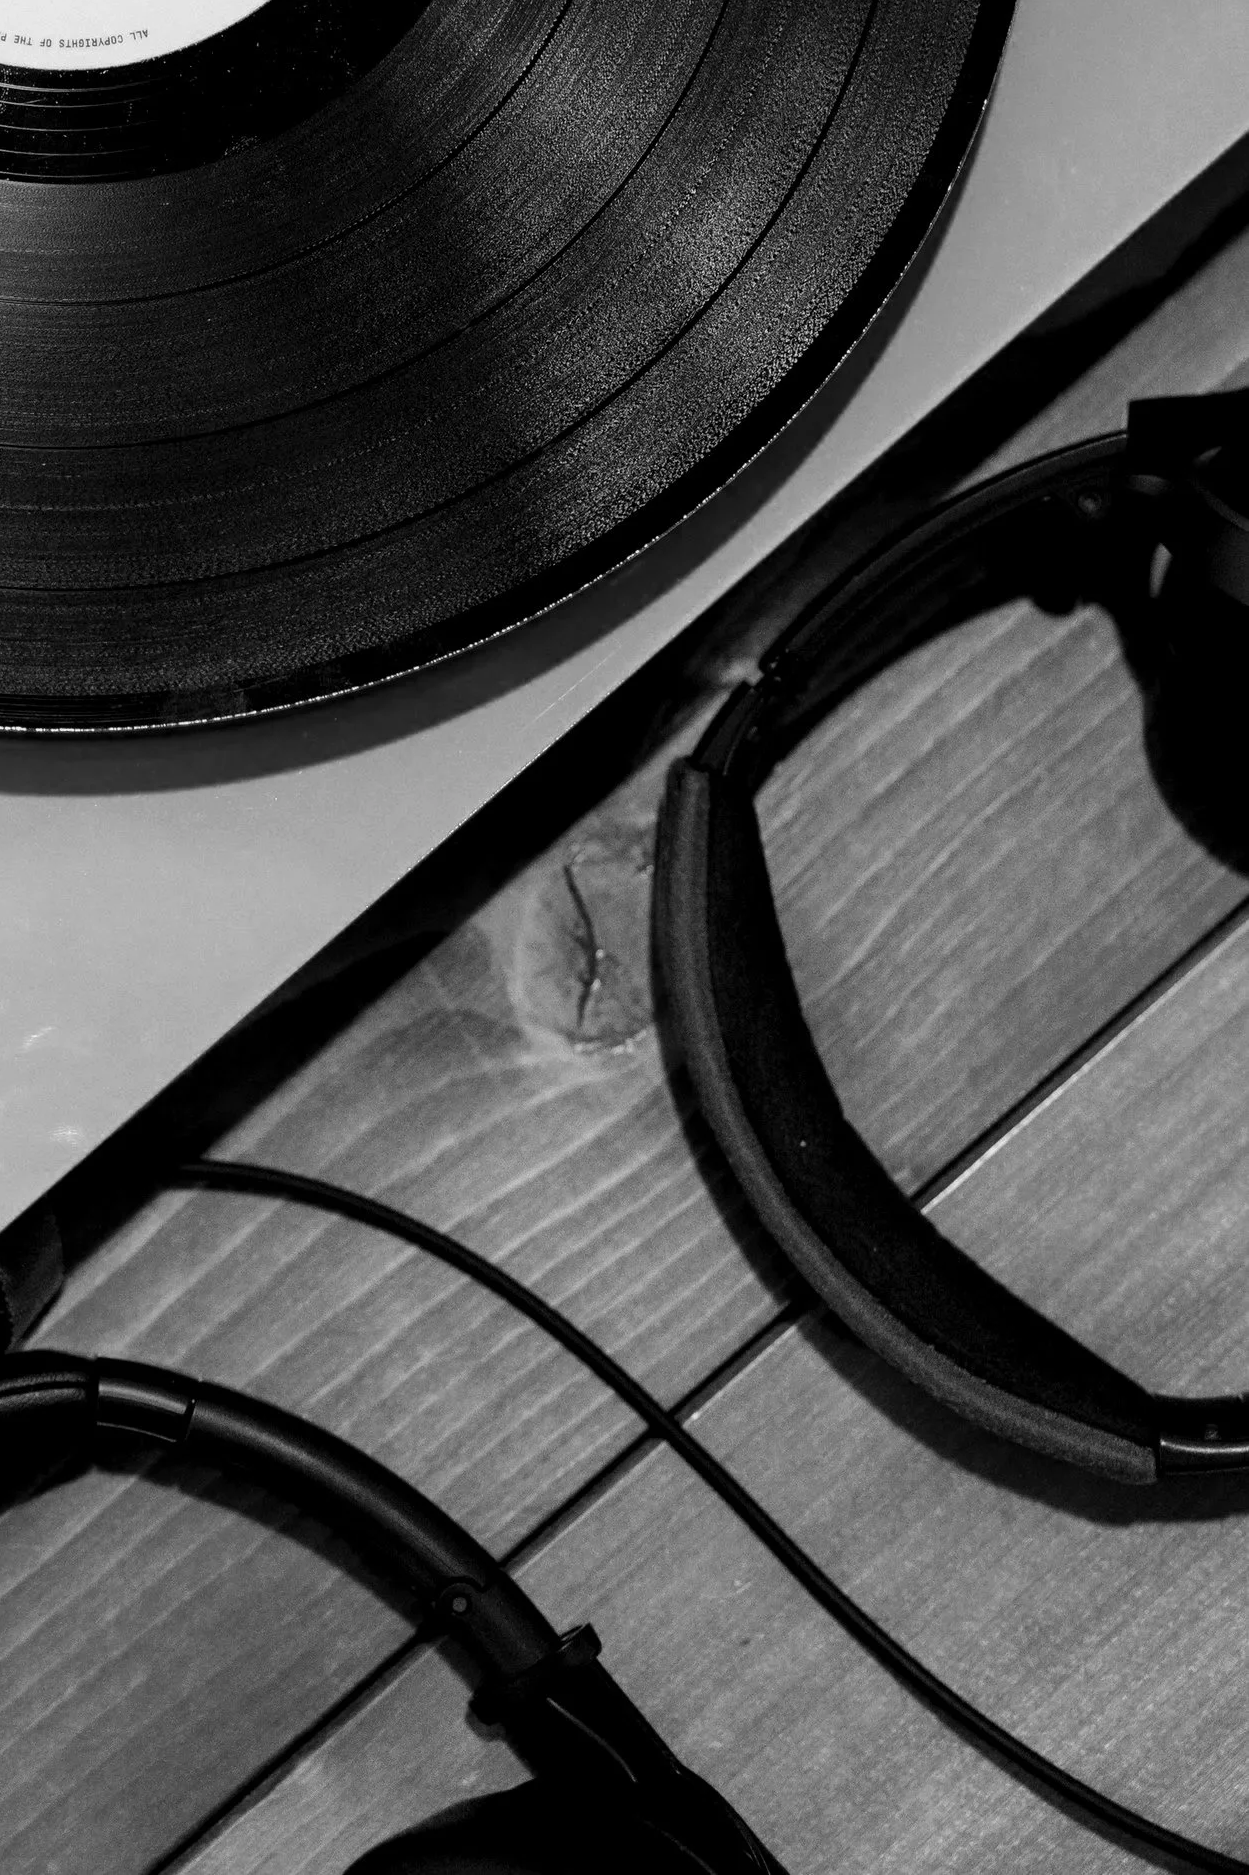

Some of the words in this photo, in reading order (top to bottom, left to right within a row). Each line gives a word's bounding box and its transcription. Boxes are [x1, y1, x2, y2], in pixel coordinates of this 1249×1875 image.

[13, 34, 34, 47] THE
[129, 29, 149, 41] ALL
[39, 38, 53, 48] OF
[58, 34, 124, 49] COPYRIGHTS
